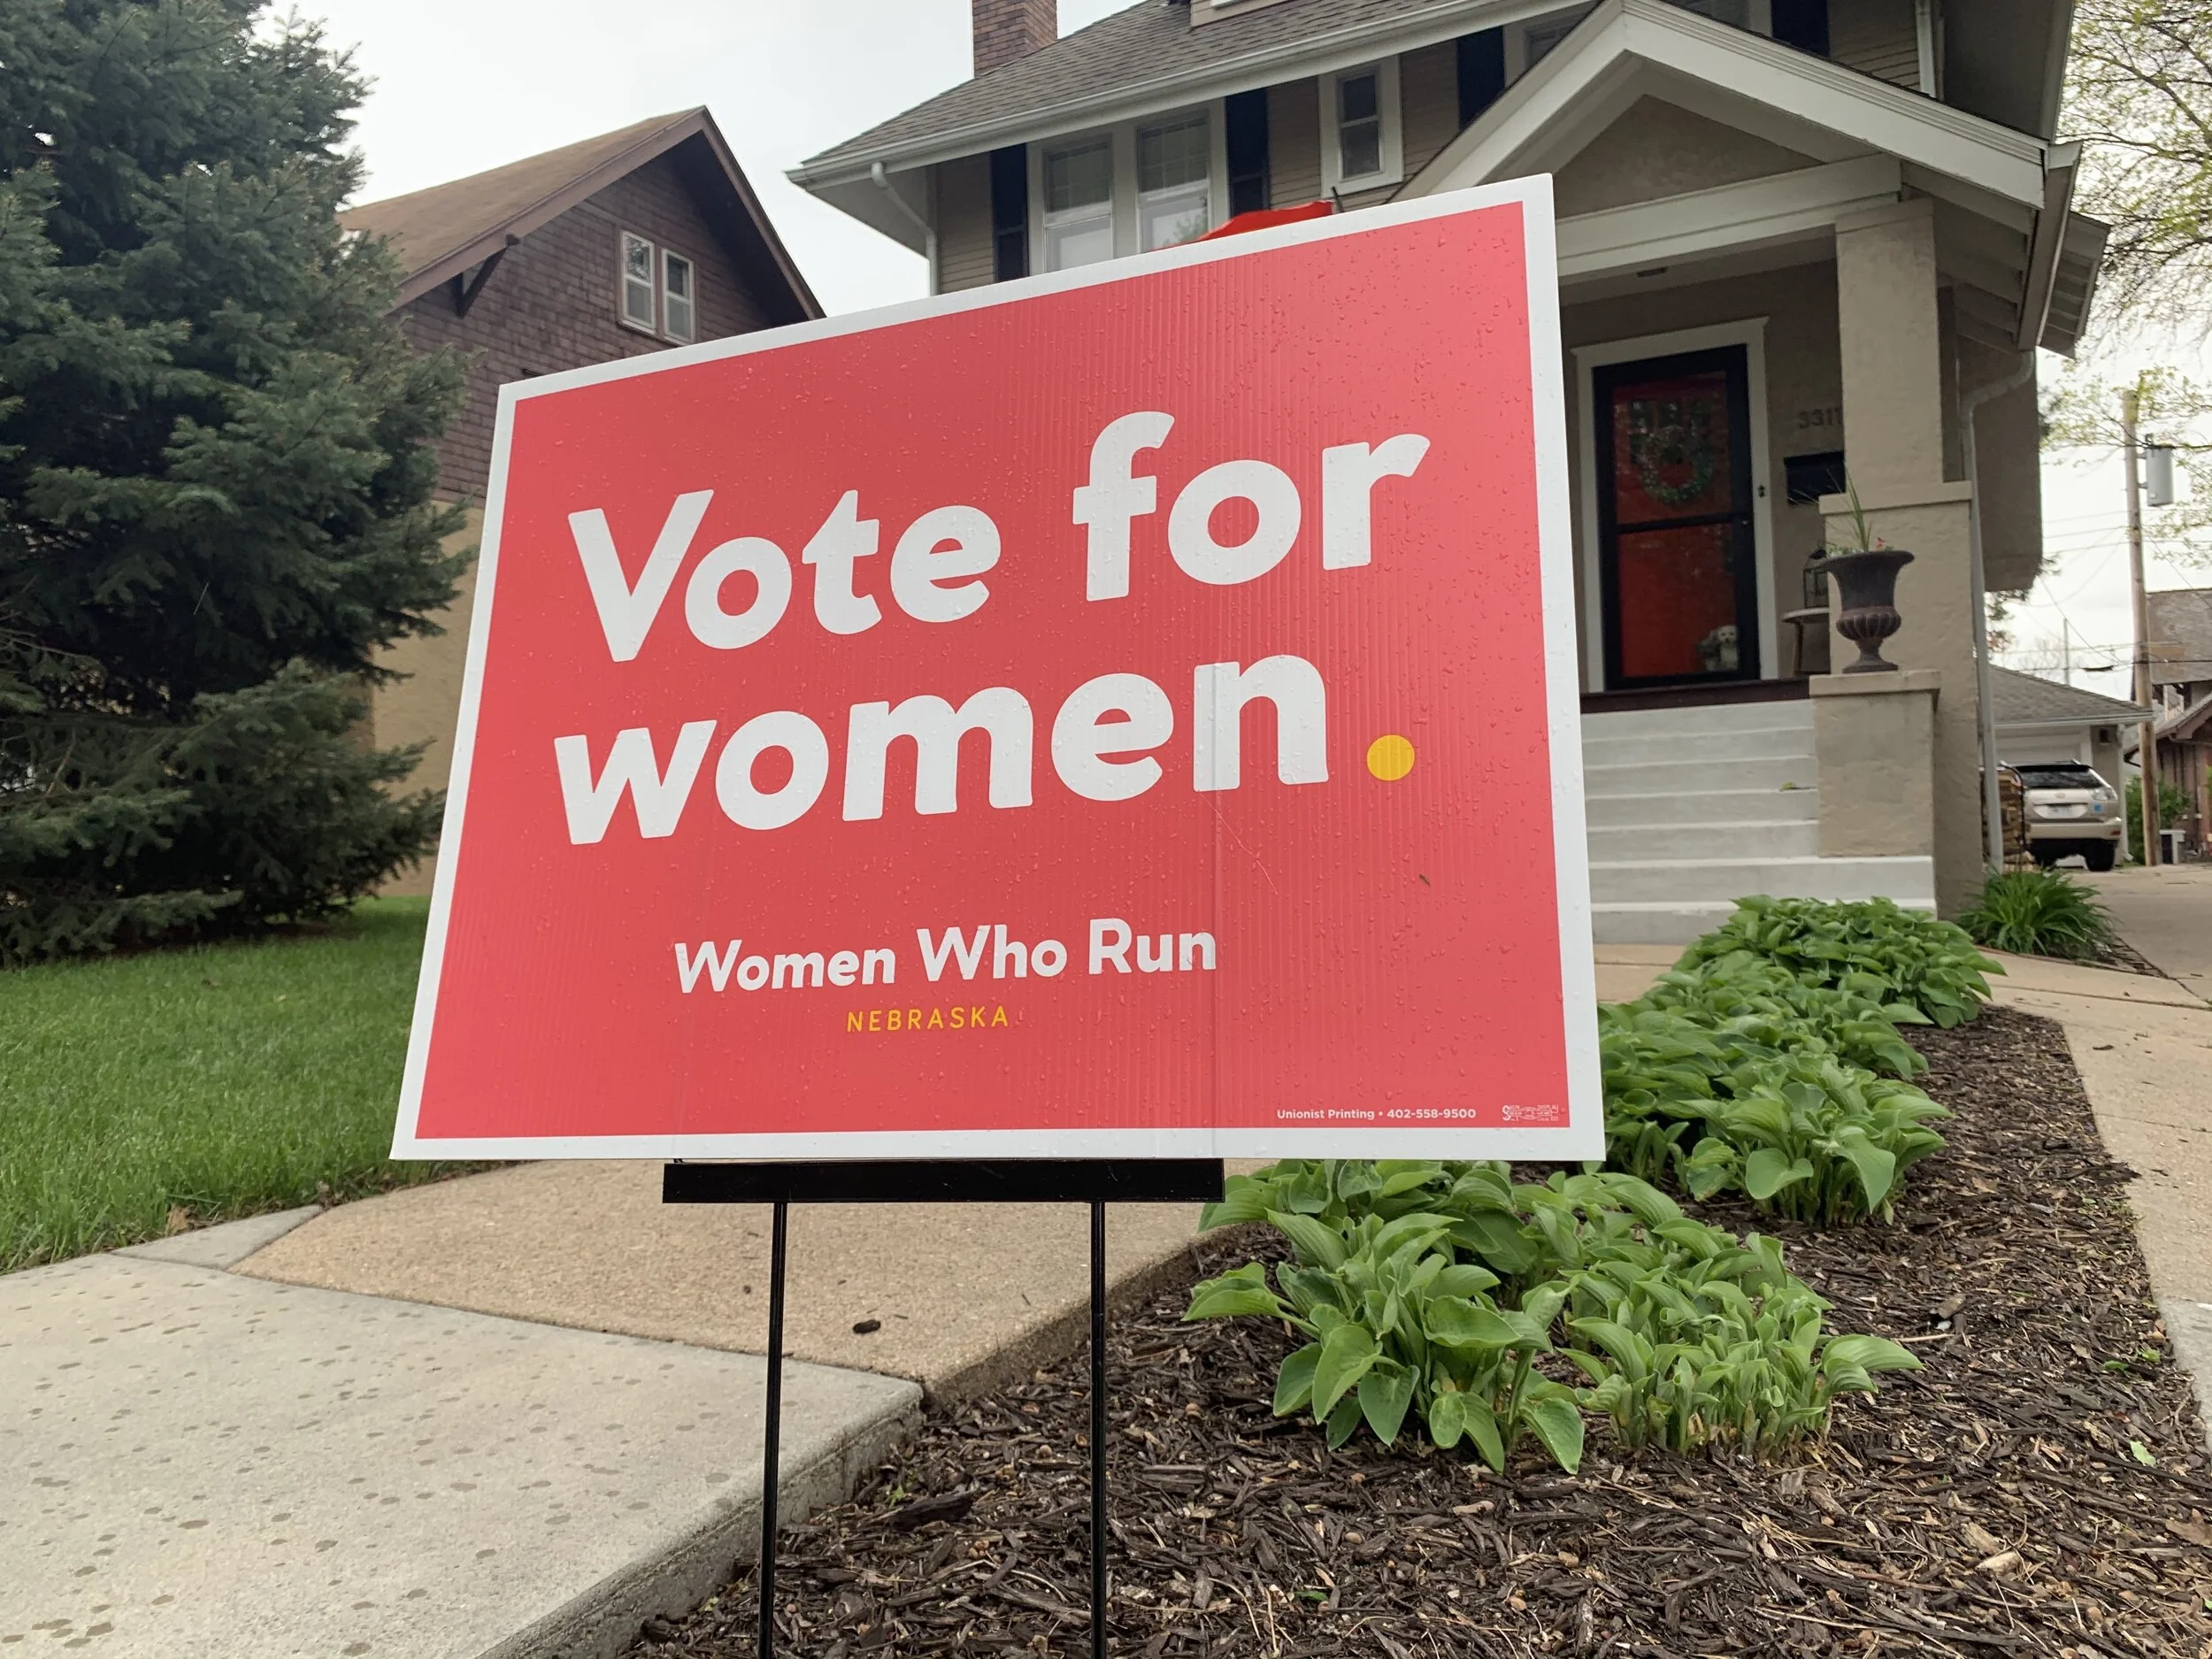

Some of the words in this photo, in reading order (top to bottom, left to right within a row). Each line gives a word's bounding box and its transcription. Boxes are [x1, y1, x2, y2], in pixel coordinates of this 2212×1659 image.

[568, 489, 1001, 662] Vote
[1073, 411, 1430, 601] for
[554, 655, 1415, 844] women.
[675, 940, 895, 993] Women
[917, 925, 1067, 981] Who
[1089, 918, 1216, 974] Run
[847, 1005, 1009, 1033] NEBRASKA
[1277, 1110, 1325, 1119] Unionist
[1327, 1109, 1375, 1120] Printing
[1386, 1108, 1477, 1118] 402-558-9500
